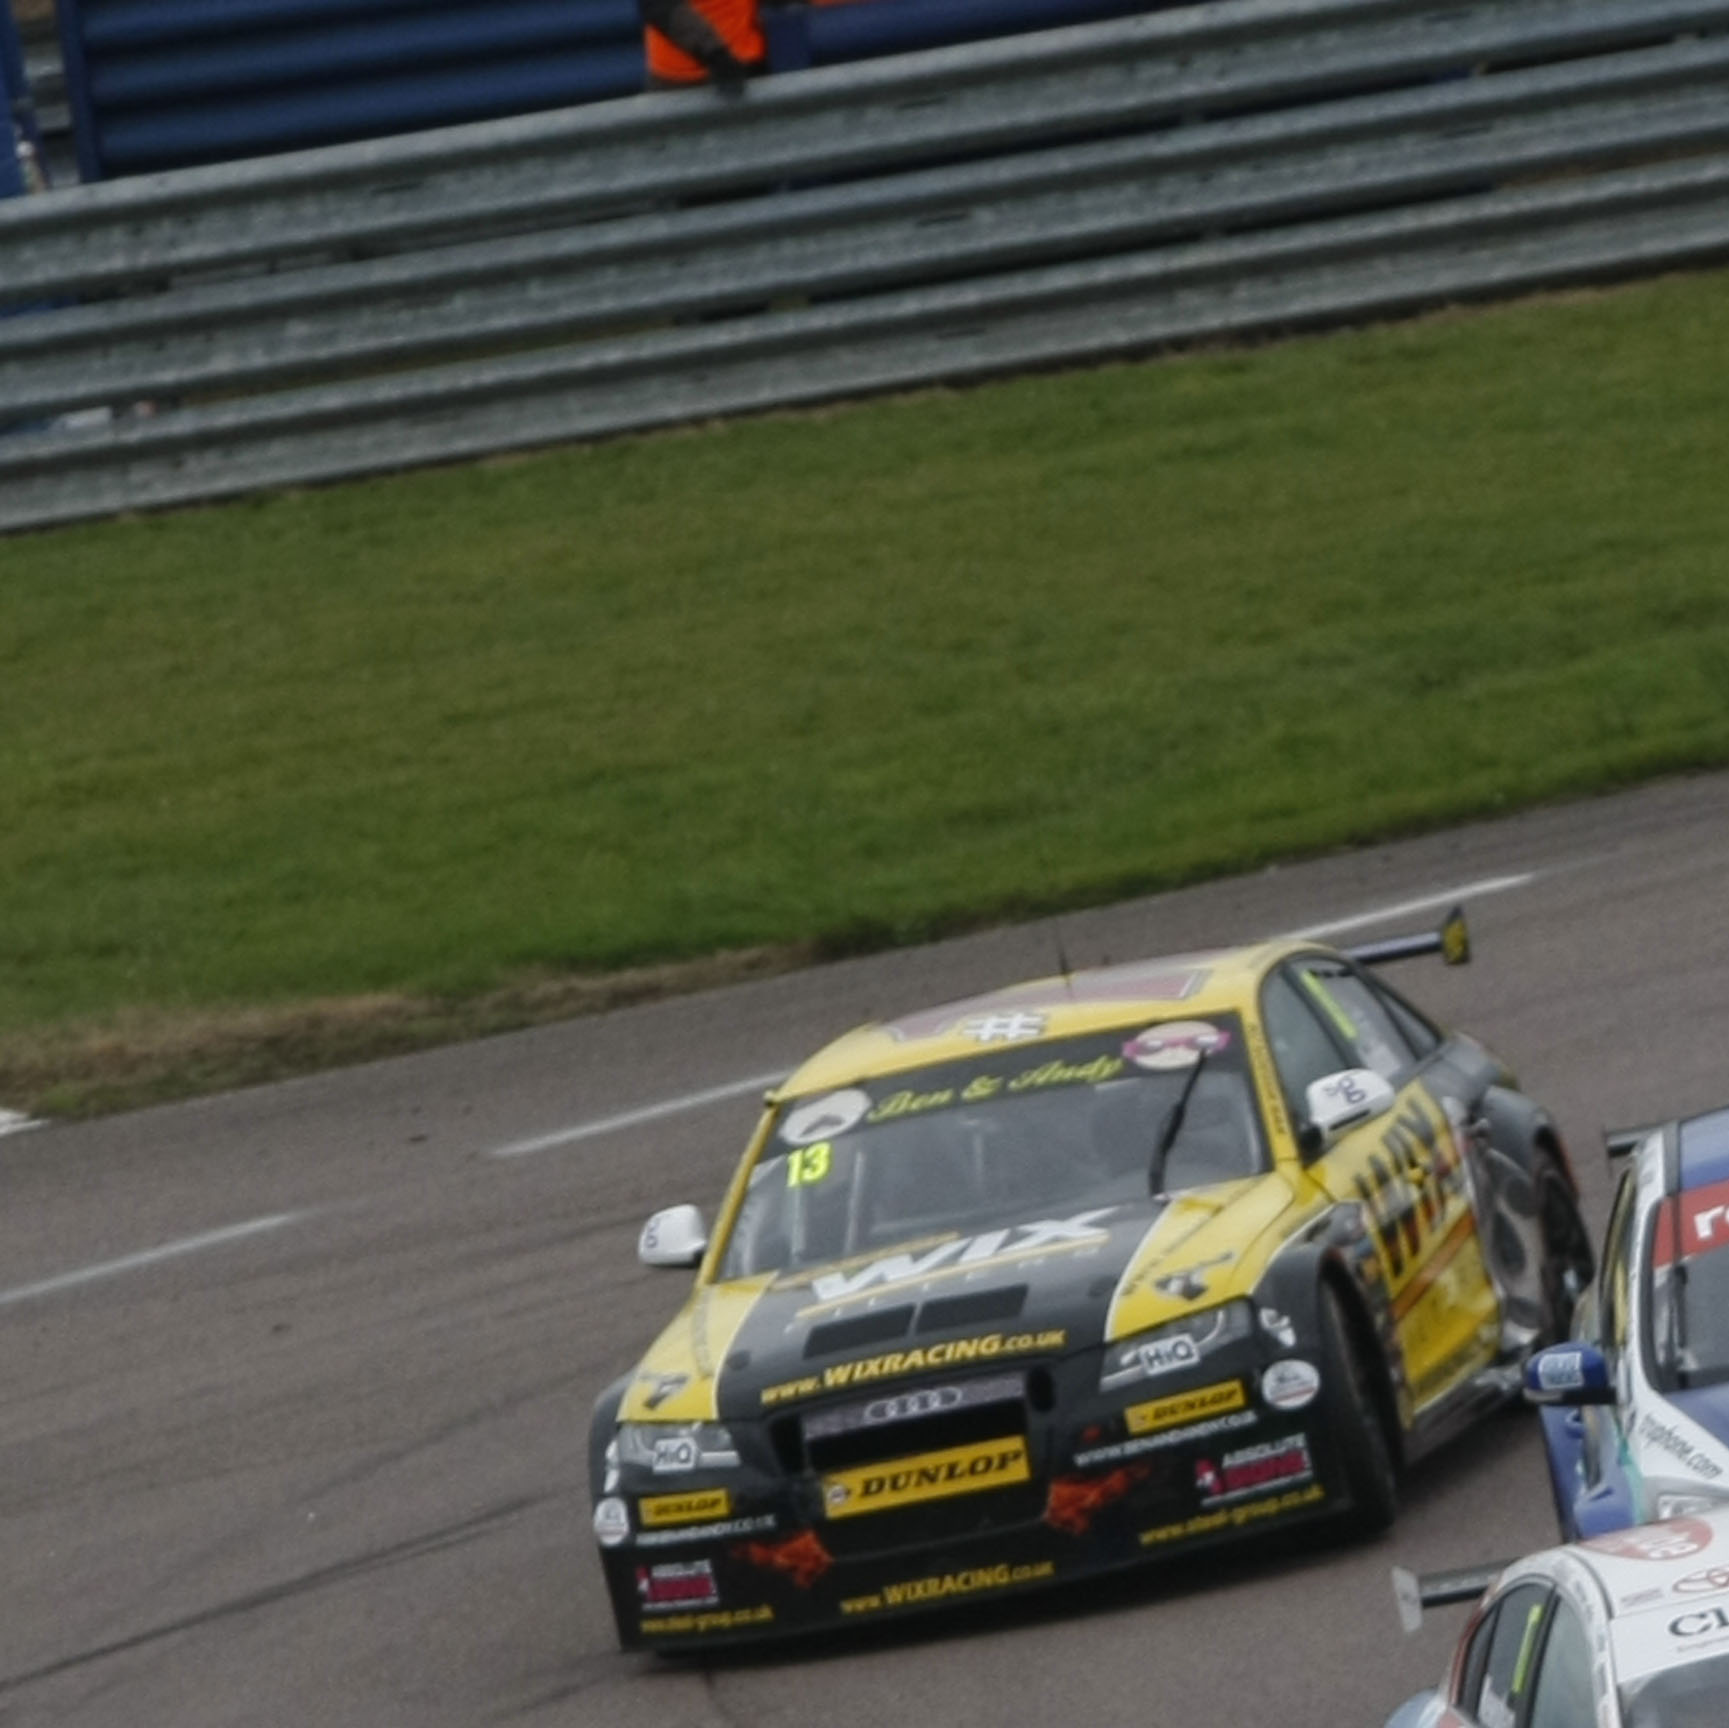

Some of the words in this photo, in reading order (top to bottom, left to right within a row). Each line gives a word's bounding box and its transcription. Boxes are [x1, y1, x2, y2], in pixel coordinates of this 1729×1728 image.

[786, 1142, 832, 1189] 13
[812, 1206, 1124, 1301] WIX
[859, 1449, 1025, 1500] DUNLOP
